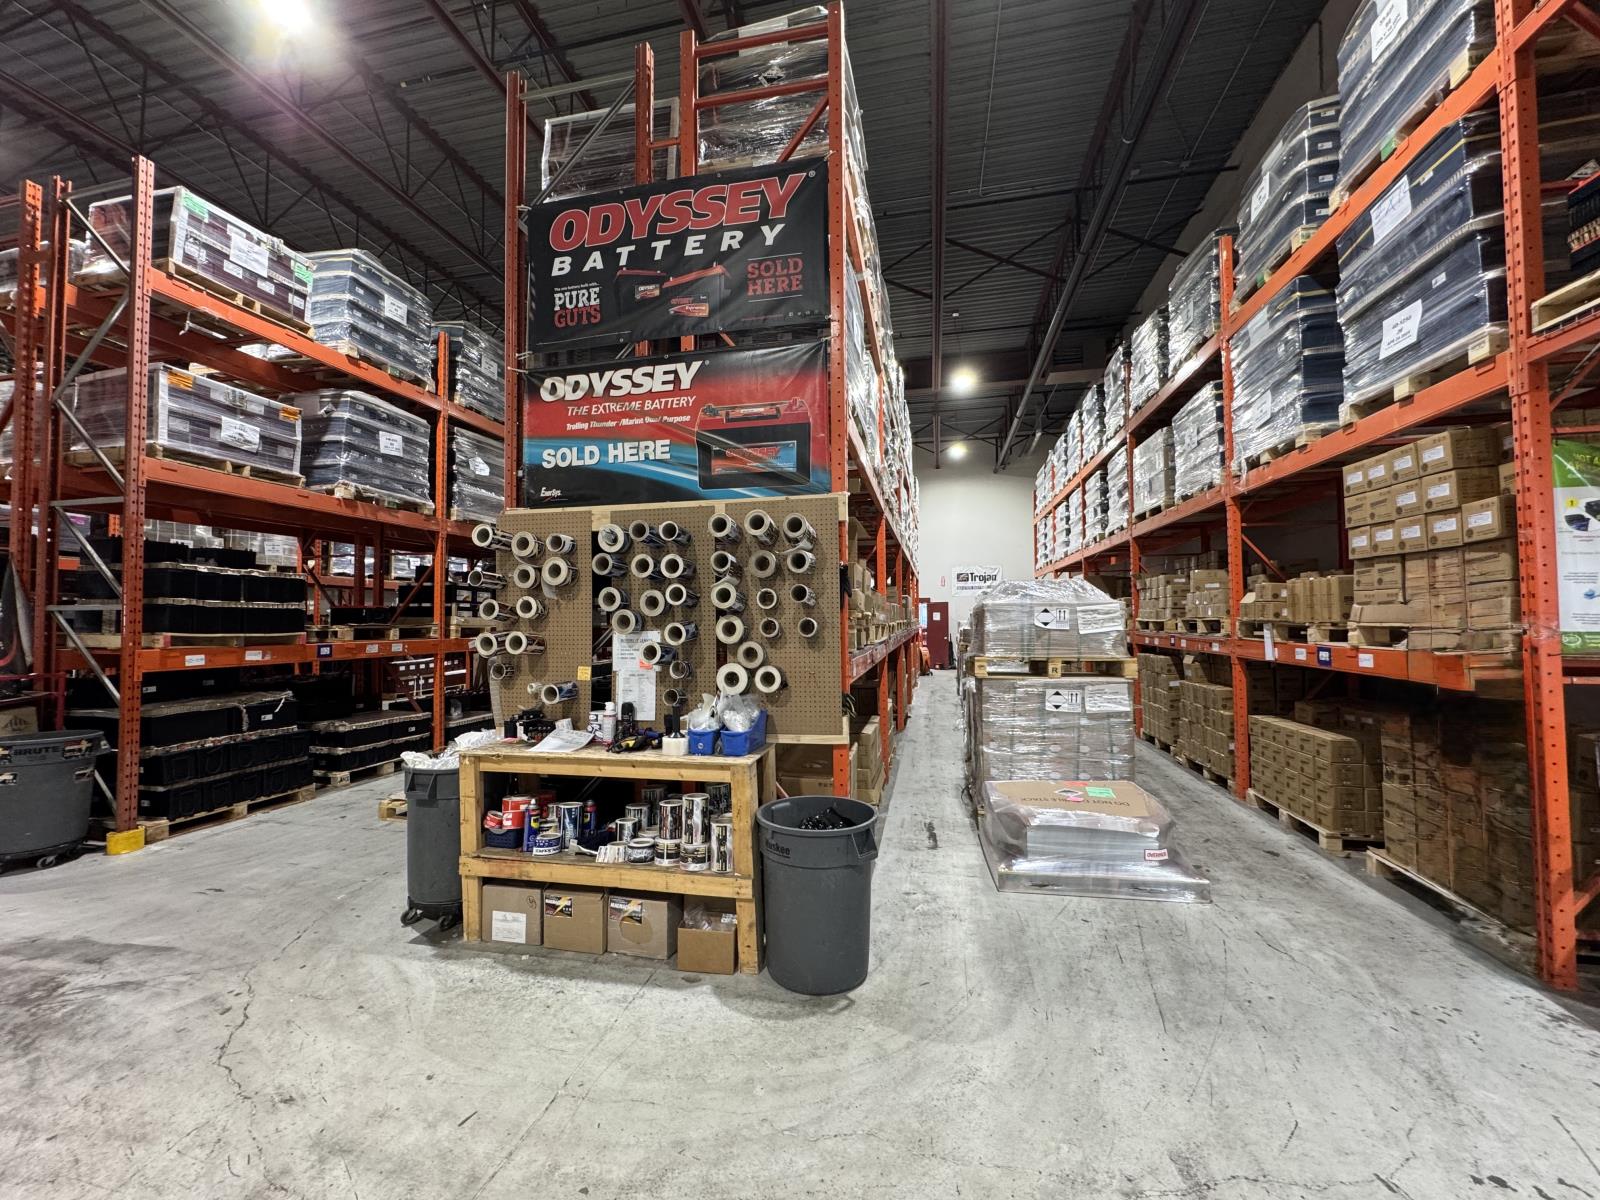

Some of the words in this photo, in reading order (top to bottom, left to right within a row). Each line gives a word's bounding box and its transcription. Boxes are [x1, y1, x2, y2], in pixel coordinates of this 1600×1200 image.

[549, 173, 806, 251] ODYSSEY
[551, 224, 785, 276] BATTERY
[746, 257, 804, 279] SOLD
[746, 275, 803, 296] HERE
[553, 287, 600, 311] PURE
[554, 304, 601, 328] GUTS
[540, 360, 703, 402] ODYSSEY
[567, 405, 590, 417] THE
[591, 400, 643, 415] EXTREME
[644, 396, 697, 411] BATTERY
[566, 422, 589, 431] Trolling
[662, 415, 691, 424] Purpose
[541, 445, 600, 469] SOLD
[608, 439, 671, 464] HERE
[969, 571, 997, 584] Trojan
[1051, 666, 1058, 674] R
